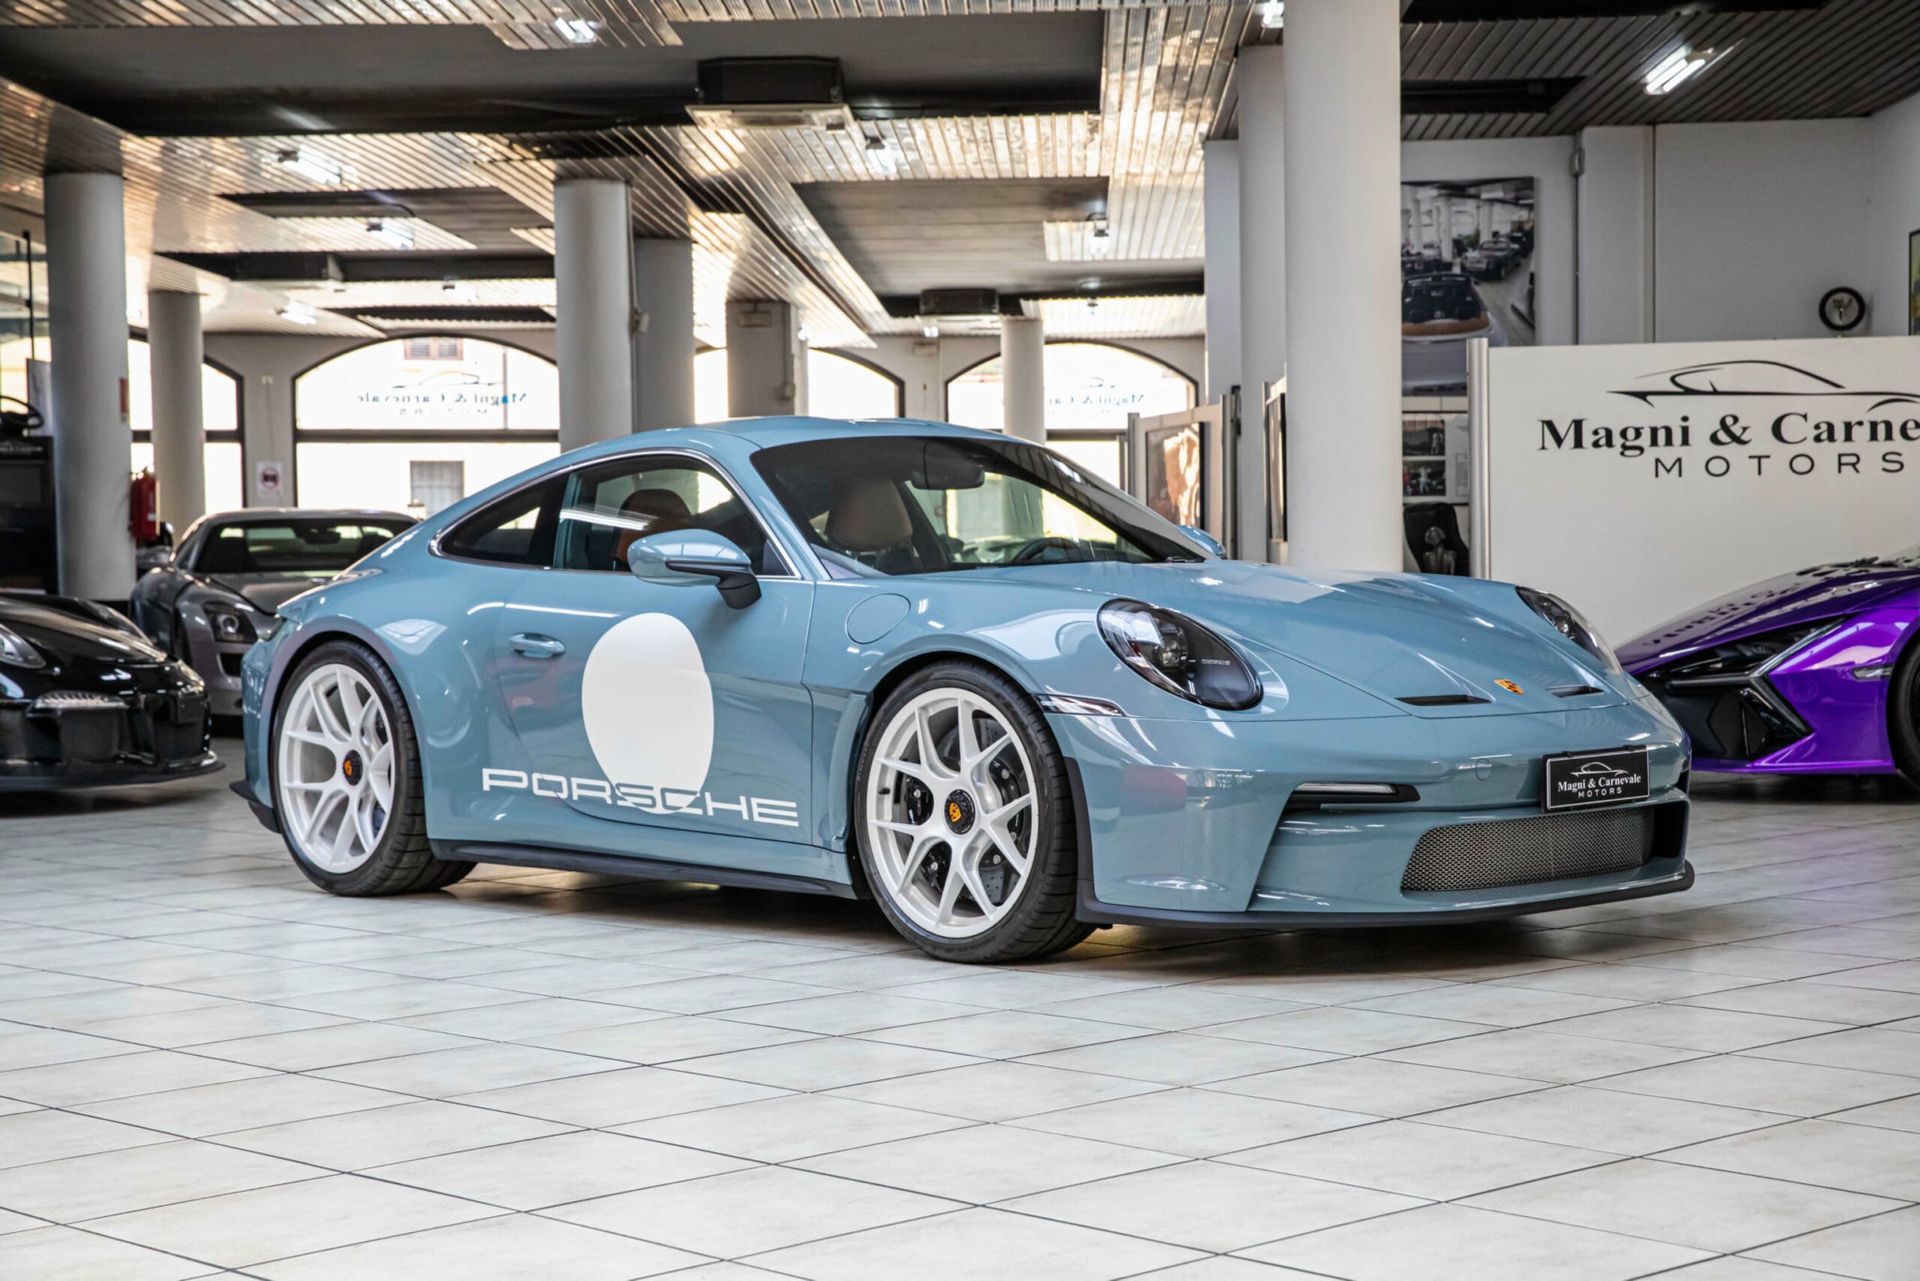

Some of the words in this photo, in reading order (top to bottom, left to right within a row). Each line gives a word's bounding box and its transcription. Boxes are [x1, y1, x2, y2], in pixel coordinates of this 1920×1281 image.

[1537, 415, 1692, 458] Magni
[1708, 413, 1753, 447] &
[1654, 451, 1905, 479] MOTORS
[1557, 779, 1586, 793] Magni
[1587, 777, 1597, 789] &
[1598, 773, 1642, 788] Carnevale
[1578, 786, 1622, 799] MOTORS
[481, 767, 800, 828] PORSCHE
